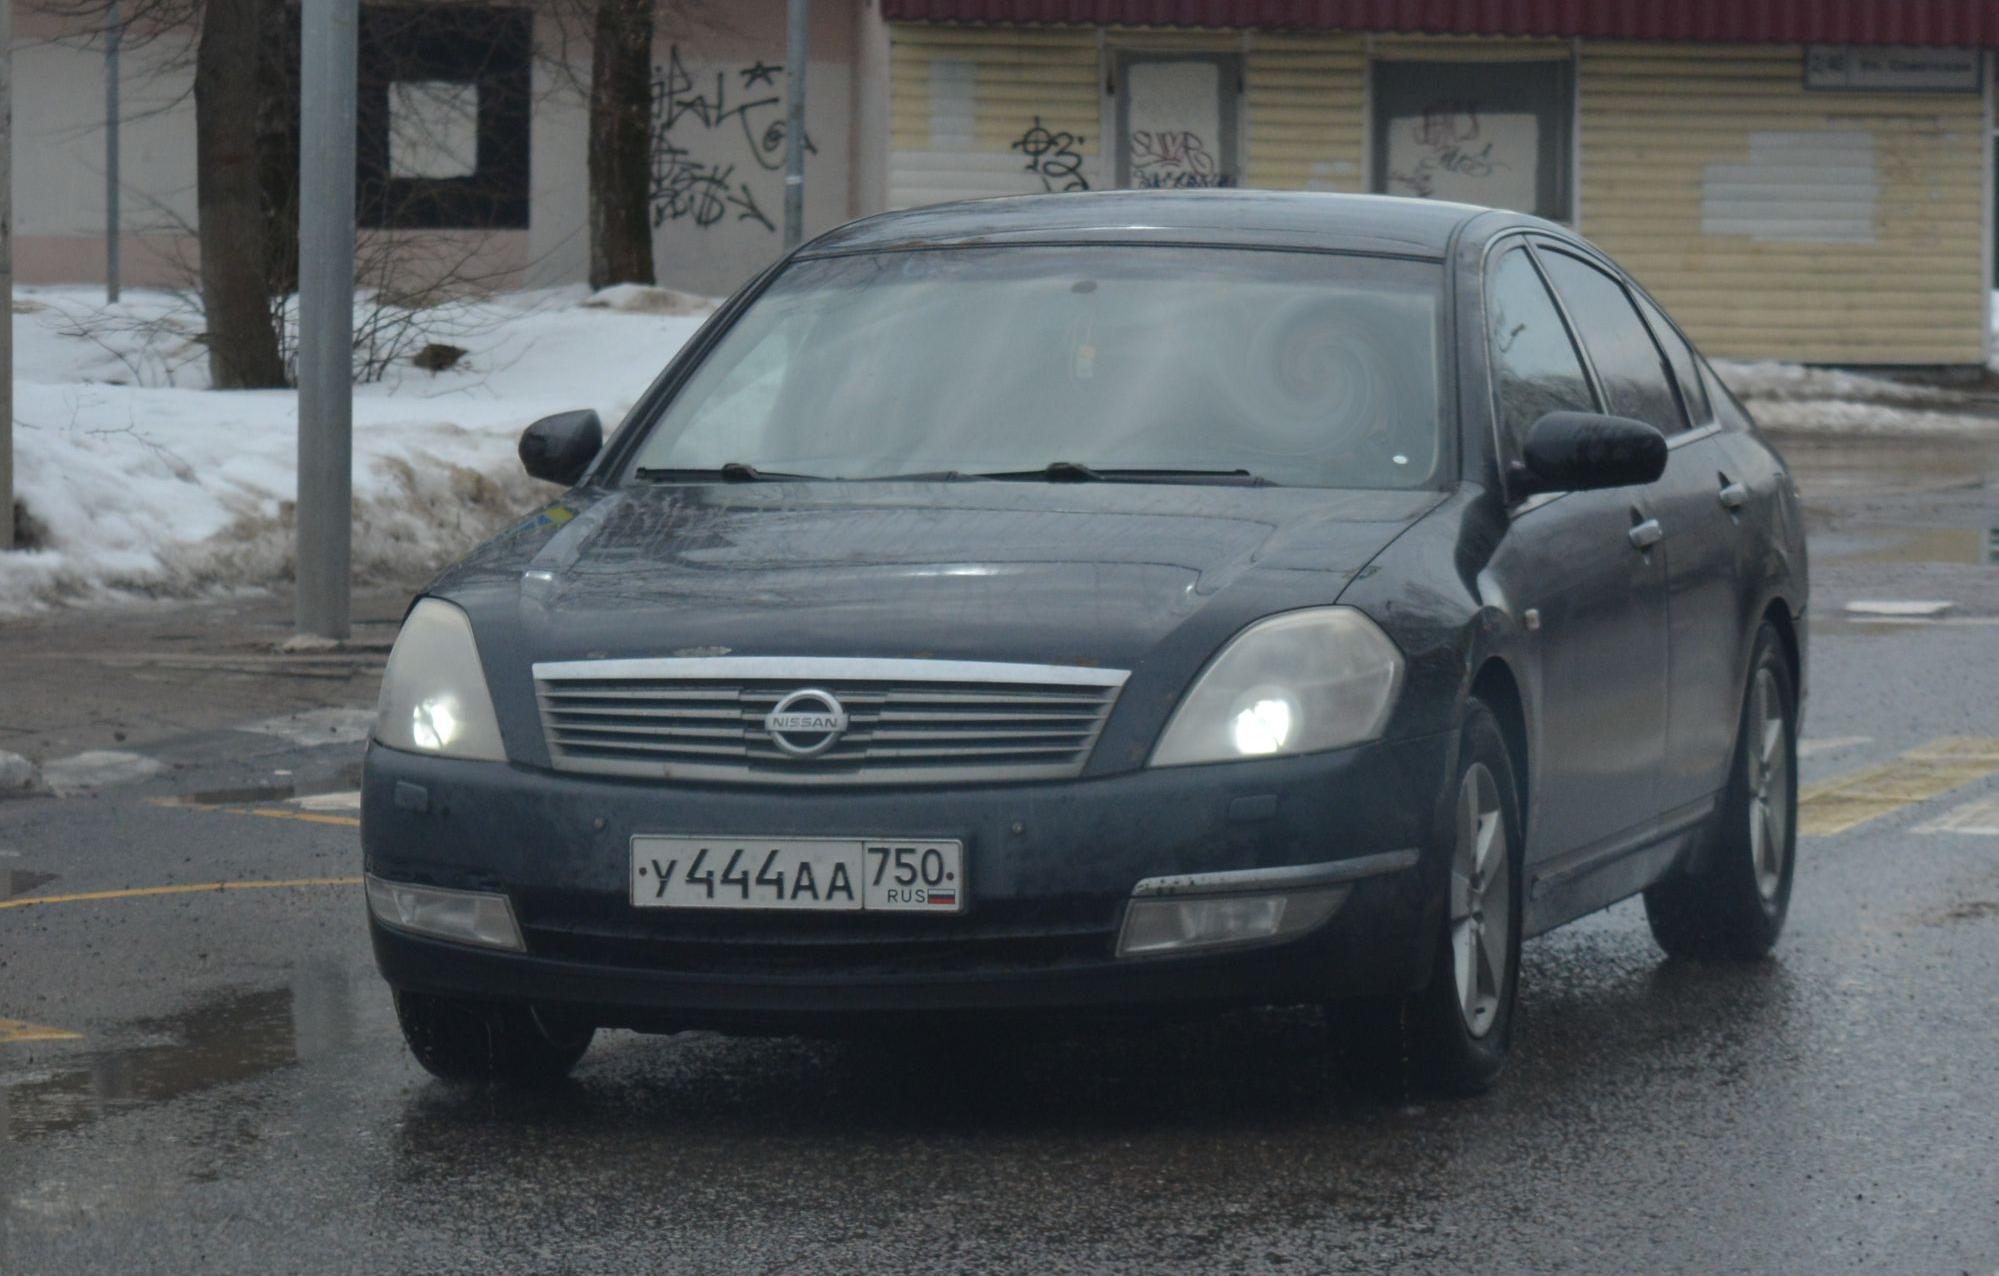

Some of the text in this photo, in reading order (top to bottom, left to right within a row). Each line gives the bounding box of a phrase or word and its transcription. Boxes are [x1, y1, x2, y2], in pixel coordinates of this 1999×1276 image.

[772, 716, 838, 729] NISSAN
[867, 847, 944, 887] 750
[887, 888, 926, 904] RUS
